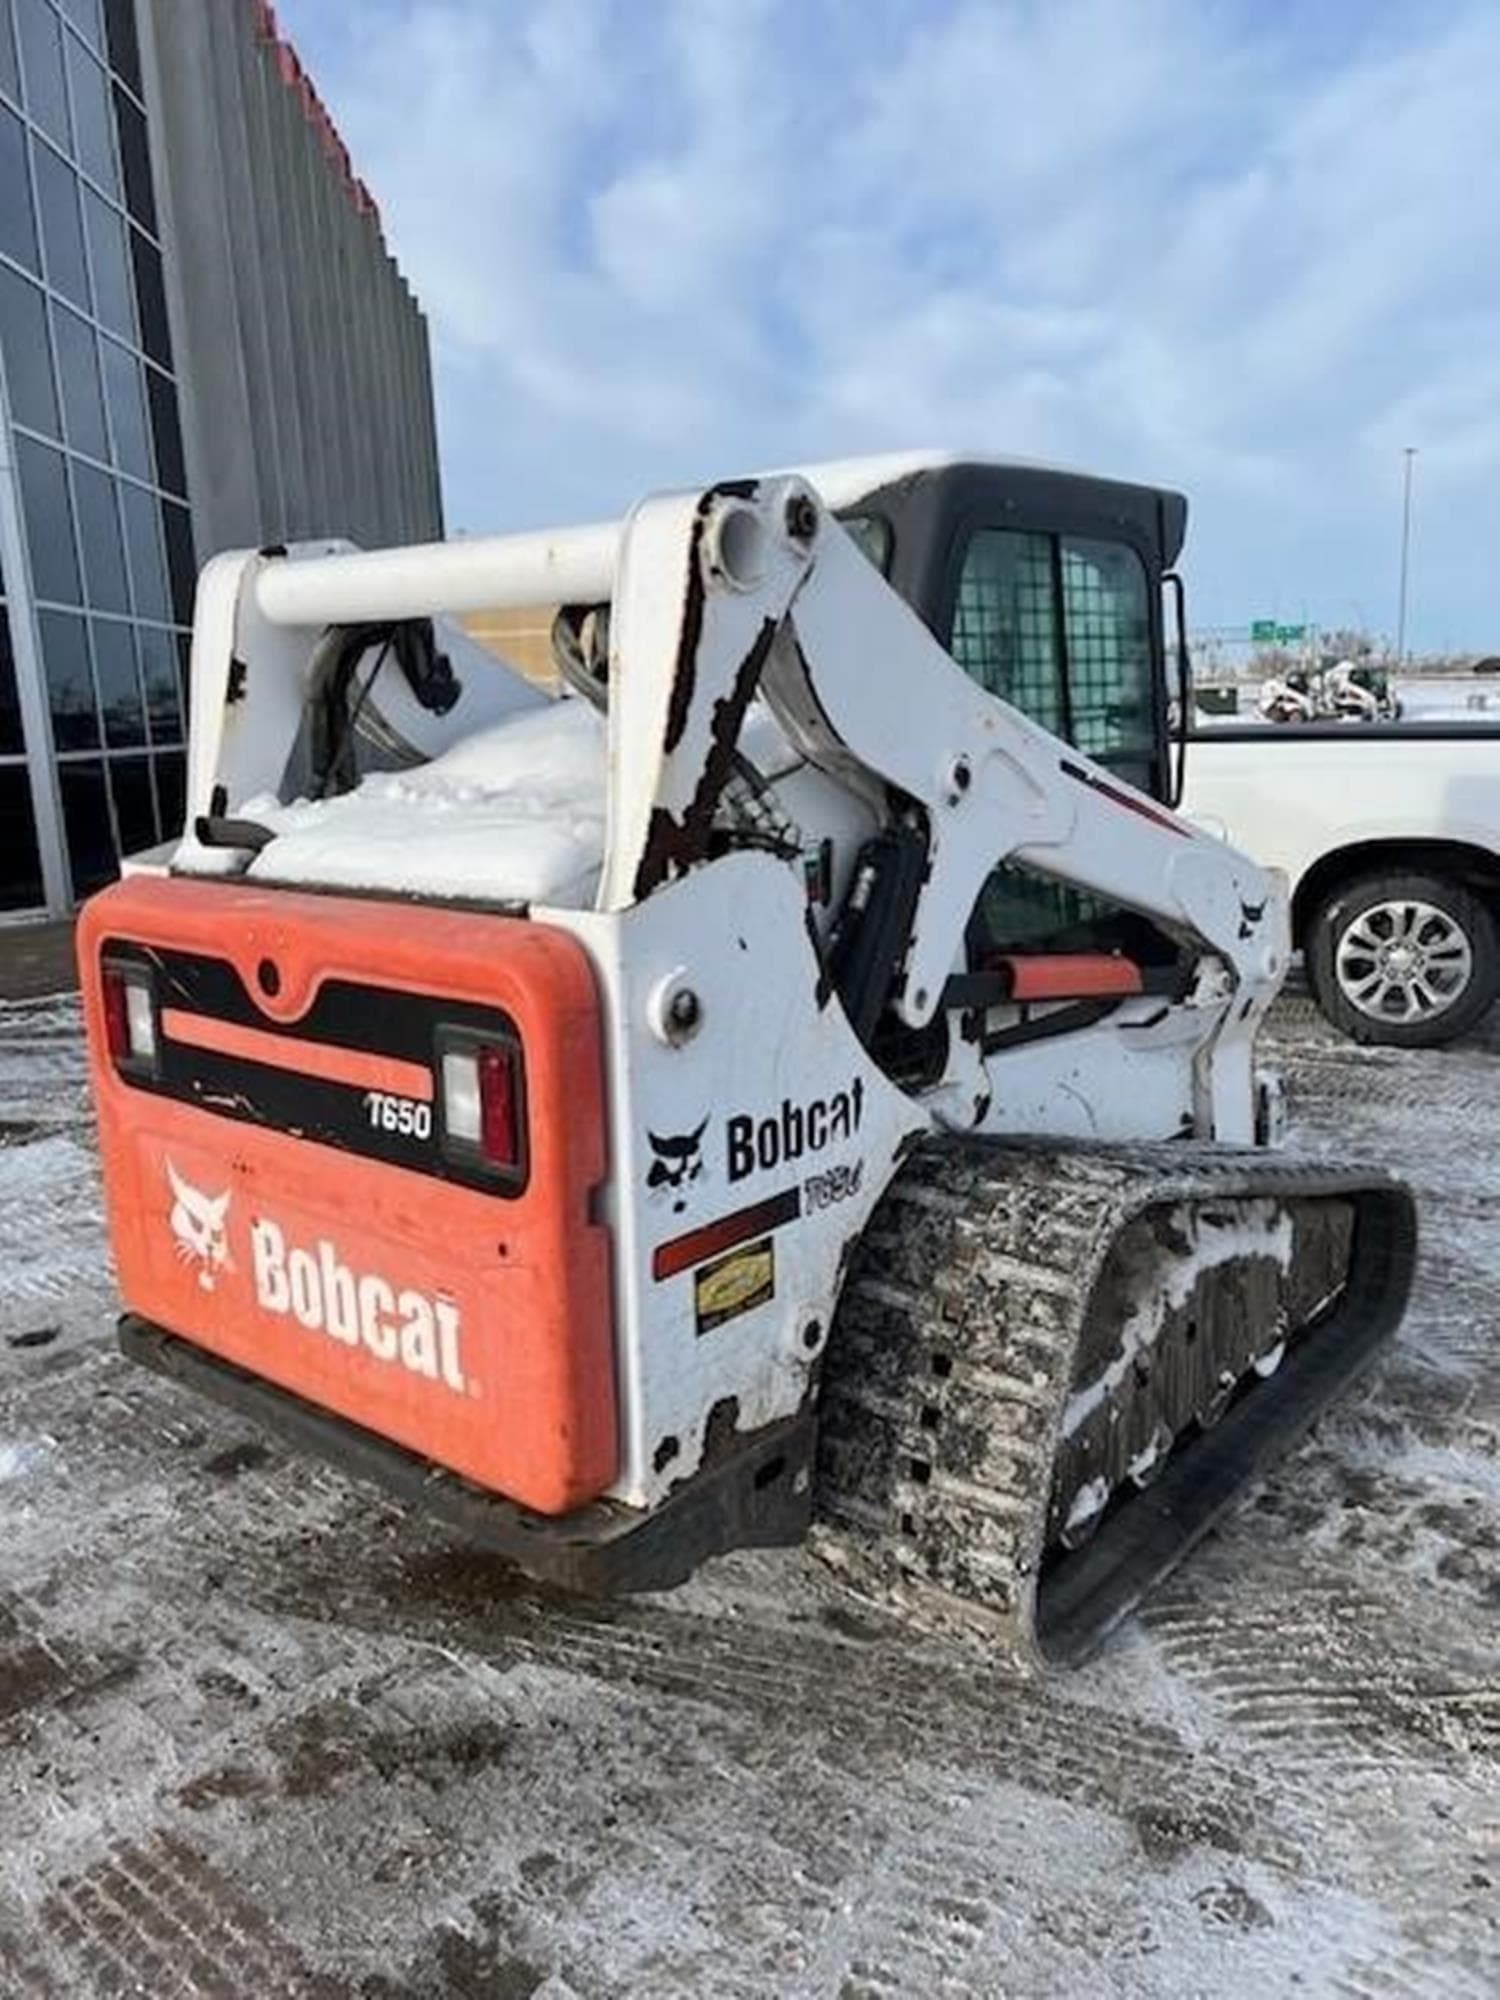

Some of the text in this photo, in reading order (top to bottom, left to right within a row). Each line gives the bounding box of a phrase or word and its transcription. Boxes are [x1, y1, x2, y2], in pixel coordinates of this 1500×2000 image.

[362, 1091, 432, 1140] T650
[726, 1075, 864, 1183] Bobcat
[250, 1217, 466, 1394] Bobcat
